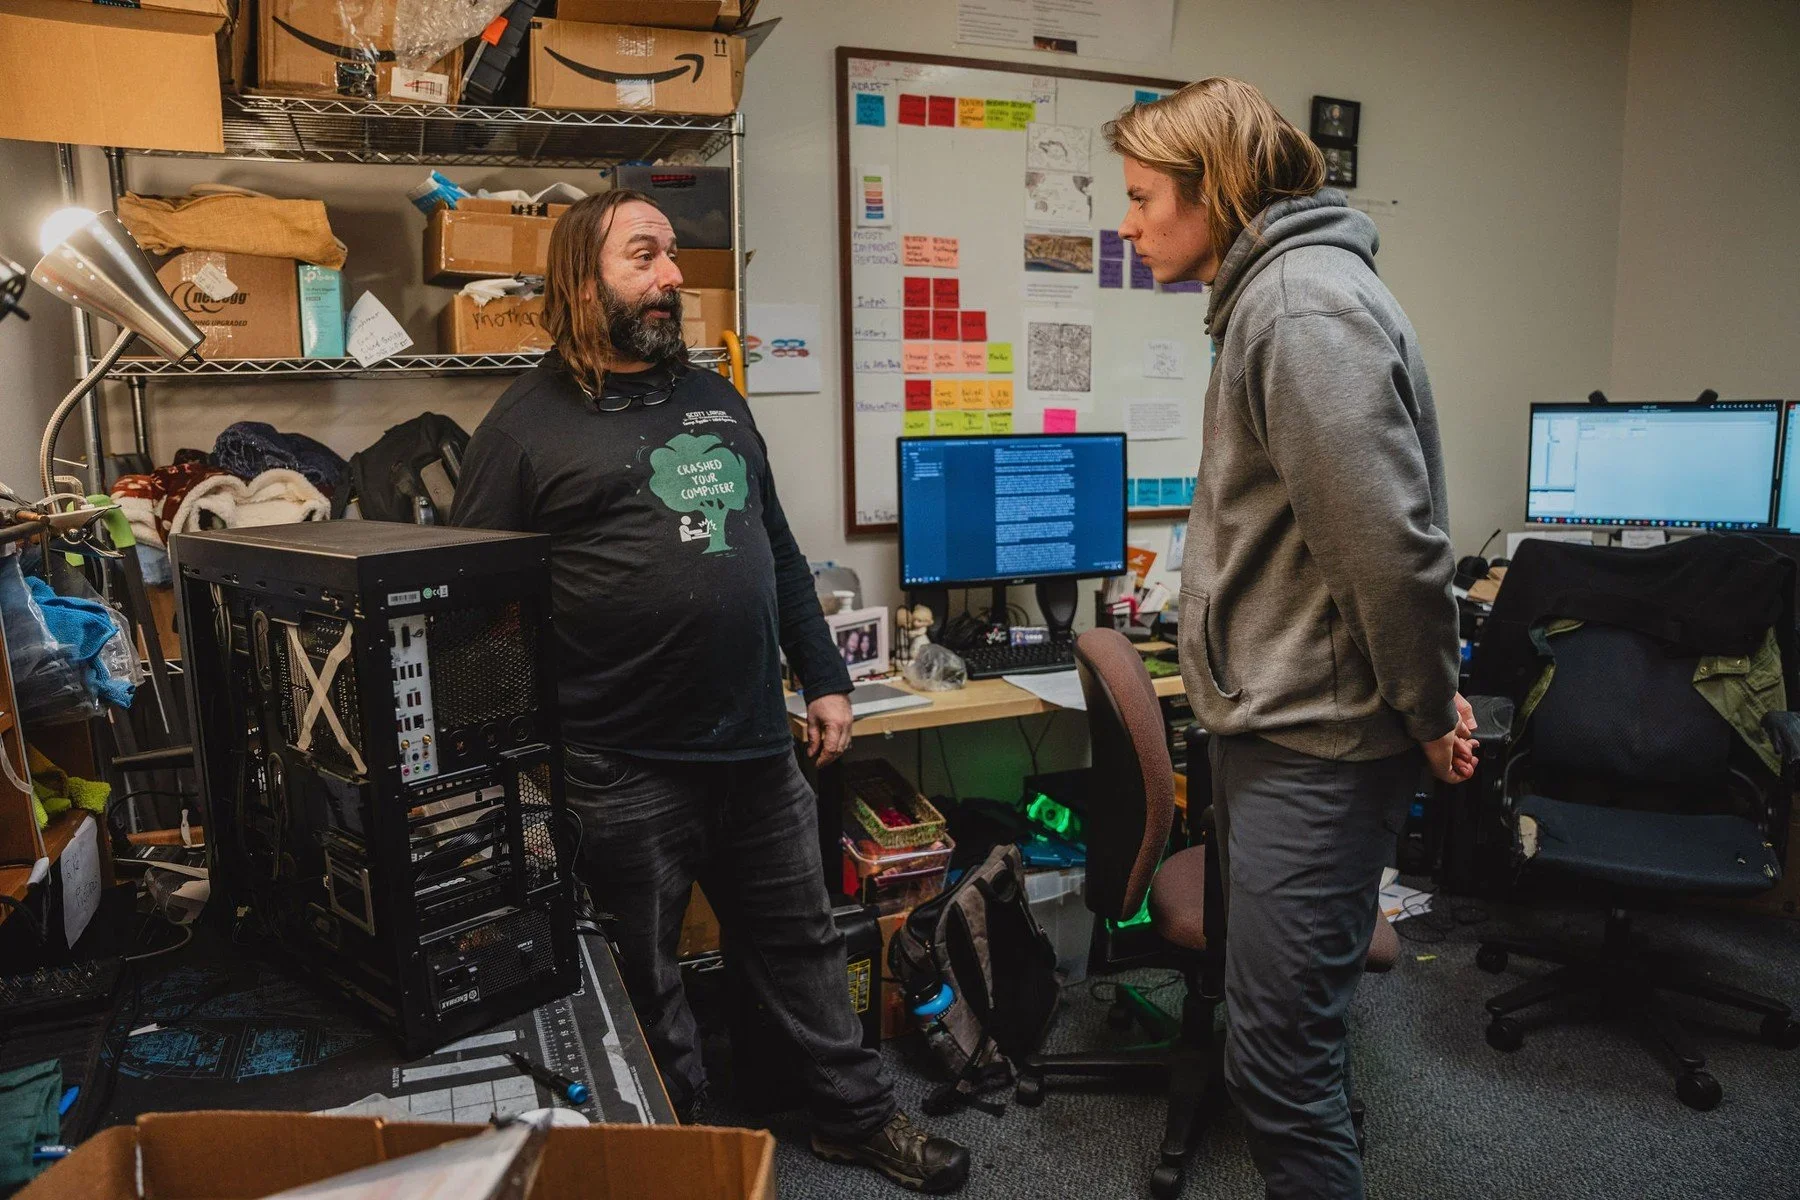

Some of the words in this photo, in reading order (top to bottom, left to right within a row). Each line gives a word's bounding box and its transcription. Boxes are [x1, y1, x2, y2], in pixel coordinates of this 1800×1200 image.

[677, 459, 723, 476] CRASHED
[691, 473, 718, 486] YOUR
[681, 481, 735, 500] COMPUTER?
